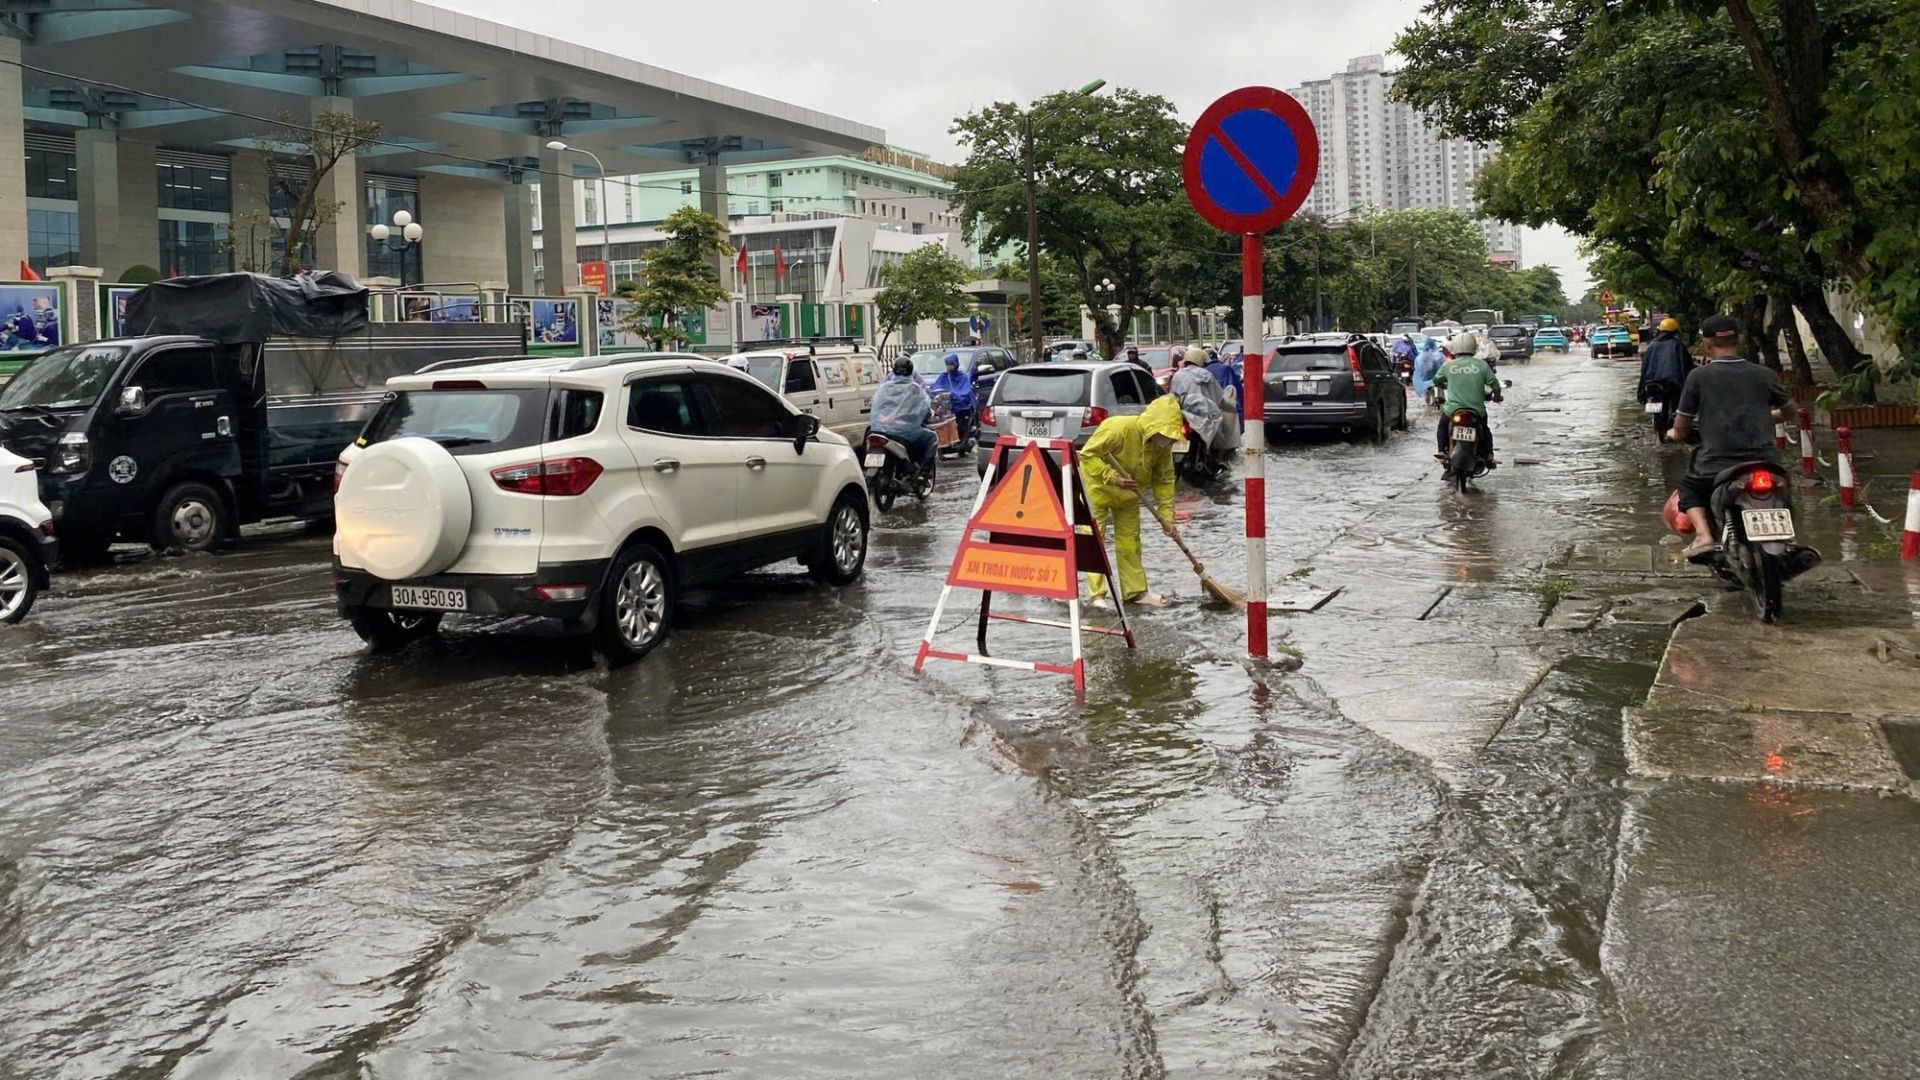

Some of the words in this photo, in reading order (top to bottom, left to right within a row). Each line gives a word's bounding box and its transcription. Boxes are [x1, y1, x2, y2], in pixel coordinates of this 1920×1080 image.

[1449, 363, 1480, 375] Grab
[1036, 563, 1050, 582] SỐ
[1051, 570, 1058, 582] 7
[393, 588, 465, 608] 30A-950.93
